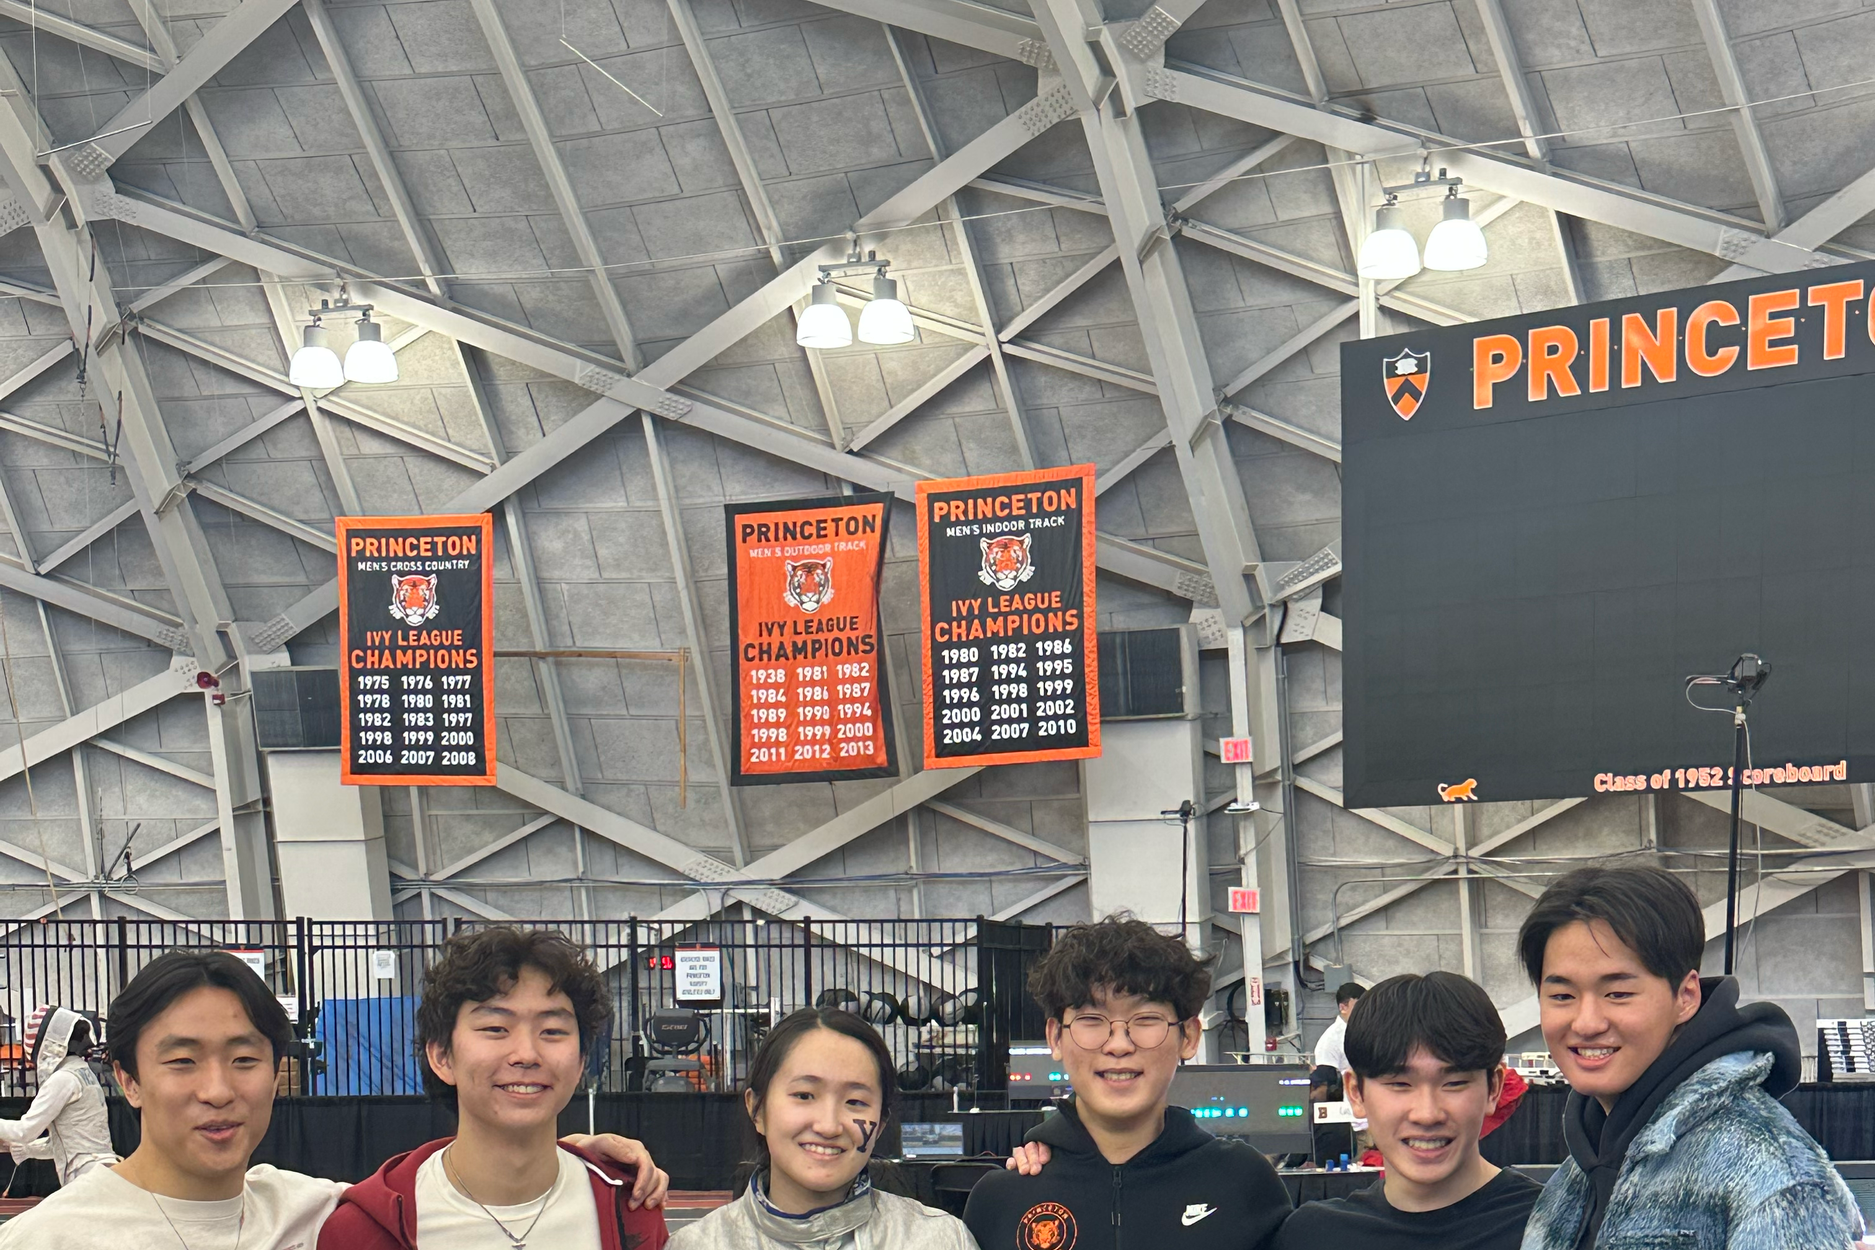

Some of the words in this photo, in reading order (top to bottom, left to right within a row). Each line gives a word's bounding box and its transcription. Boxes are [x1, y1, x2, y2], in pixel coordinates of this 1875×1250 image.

[1473, 279, 1875, 409] PRINCET
[934, 488, 1077, 522] PRINCETON
[741, 514, 876, 544] PRINCETON
[946, 523, 980, 537] MEN'S
[982, 519, 1026, 534] INDOOR
[1028, 515, 1065, 530] TRACK
[351, 535, 477, 557] PRINCETON
[784, 543, 832, 557] OUTDOOR
[834, 540, 866, 551] TRACK
[357, 561, 388, 571] MEN'S
[390, 561, 423, 571] CROSS
[425, 559, 470, 570] COUNTRY
[952, 598, 982, 617] IVY
[987, 591, 1062, 613] LEAGUE
[758, 621, 787, 638] IVY
[793, 615, 859, 636] LEAGUE
[934, 609, 1079, 643] CHAMPIONS
[366, 631, 391, 646] IVY
[398, 629, 463, 646] LEAGUE
[743, 633, 875, 662] CHAMPIONS
[351, 649, 478, 669] CHAMPIONS
[941, 647, 979, 664] 1980
[990, 643, 1027, 660] 1982
[1035, 638, 1072, 656] 1986
[358, 675, 390, 690] 1975
[401, 675, 433, 690] 1976
[441, 675, 471, 689] 1977
[751, 669, 785, 684] 1938
[796, 665, 828, 681] 1981
[836, 662, 870, 679] 1982
[942, 667, 979, 684] 1987
[991, 663, 1028, 680] 1994
[1036, 659, 1073, 676] 1995
[357, 694, 390, 708] 1978
[402, 694, 433, 708] 1980
[442, 694, 471, 708] 1981
[751, 688, 786, 704] 1984
[797, 686, 829, 701] 1986
[837, 682, 870, 699] 1987
[942, 687, 980, 704] 1996
[991, 683, 1028, 700] 1998
[1036, 679, 1074, 697] 1999
[358, 713, 391, 727] 1982
[403, 713, 434, 727] 1983
[442, 713, 473, 727] 1997
[751, 708, 786, 723] 1989
[797, 705, 830, 721] 1990
[837, 702, 872, 719] 1994
[941, 706, 980, 724] 2000
[990, 703, 1028, 720] 2001
[1036, 699, 1075, 716] 2002
[359, 731, 392, 746] 1998
[403, 731, 434, 745] 1999
[441, 731, 474, 746] 2000
[751, 727, 787, 743] 1998
[798, 725, 831, 741] 1999
[837, 722, 873, 738] 2000
[943, 726, 982, 744] 2004
[991, 723, 1029, 740] 2007
[1038, 719, 1076, 736] 2010
[358, 750, 393, 764] 2006
[400, 750, 435, 765] 2007
[441, 751, 476, 766] 2008
[750, 747, 786, 762] 2011
[794, 744, 831, 759] 2012
[839, 741, 874, 757] 2013
[1223, 739, 1250, 762] EXIT
[1594, 772, 1647, 793] Class
[1650, 768, 1670, 790] of
[1674, 767, 1723, 789] 1952
[1232, 890, 1258, 911] EXIT
[852, 1118, 877, 1153] Y
